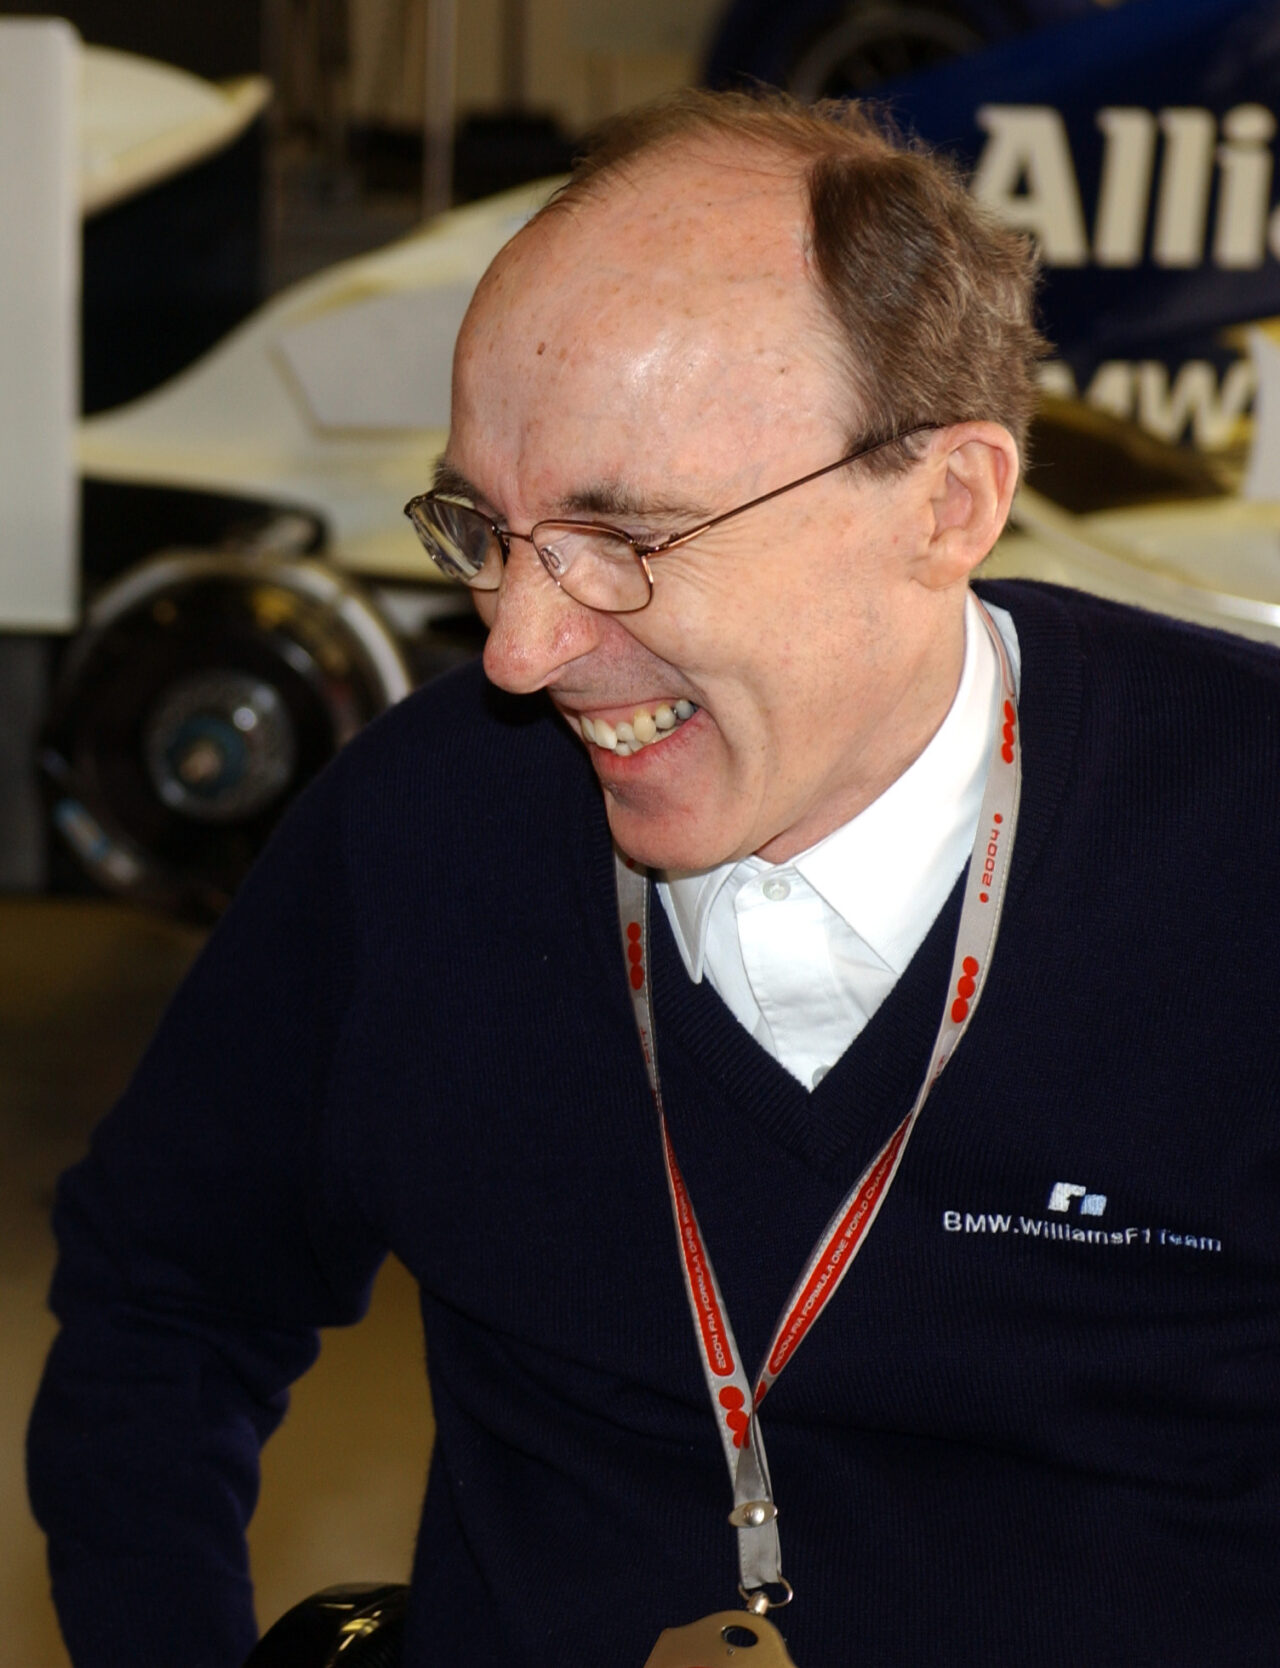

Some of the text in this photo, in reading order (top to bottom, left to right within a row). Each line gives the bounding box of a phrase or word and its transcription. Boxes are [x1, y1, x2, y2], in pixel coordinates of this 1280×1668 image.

[968, 105, 1280, 270] Alli
[982, 829, 1000, 887] 2004
[711, 1334, 727, 1369] 2004
